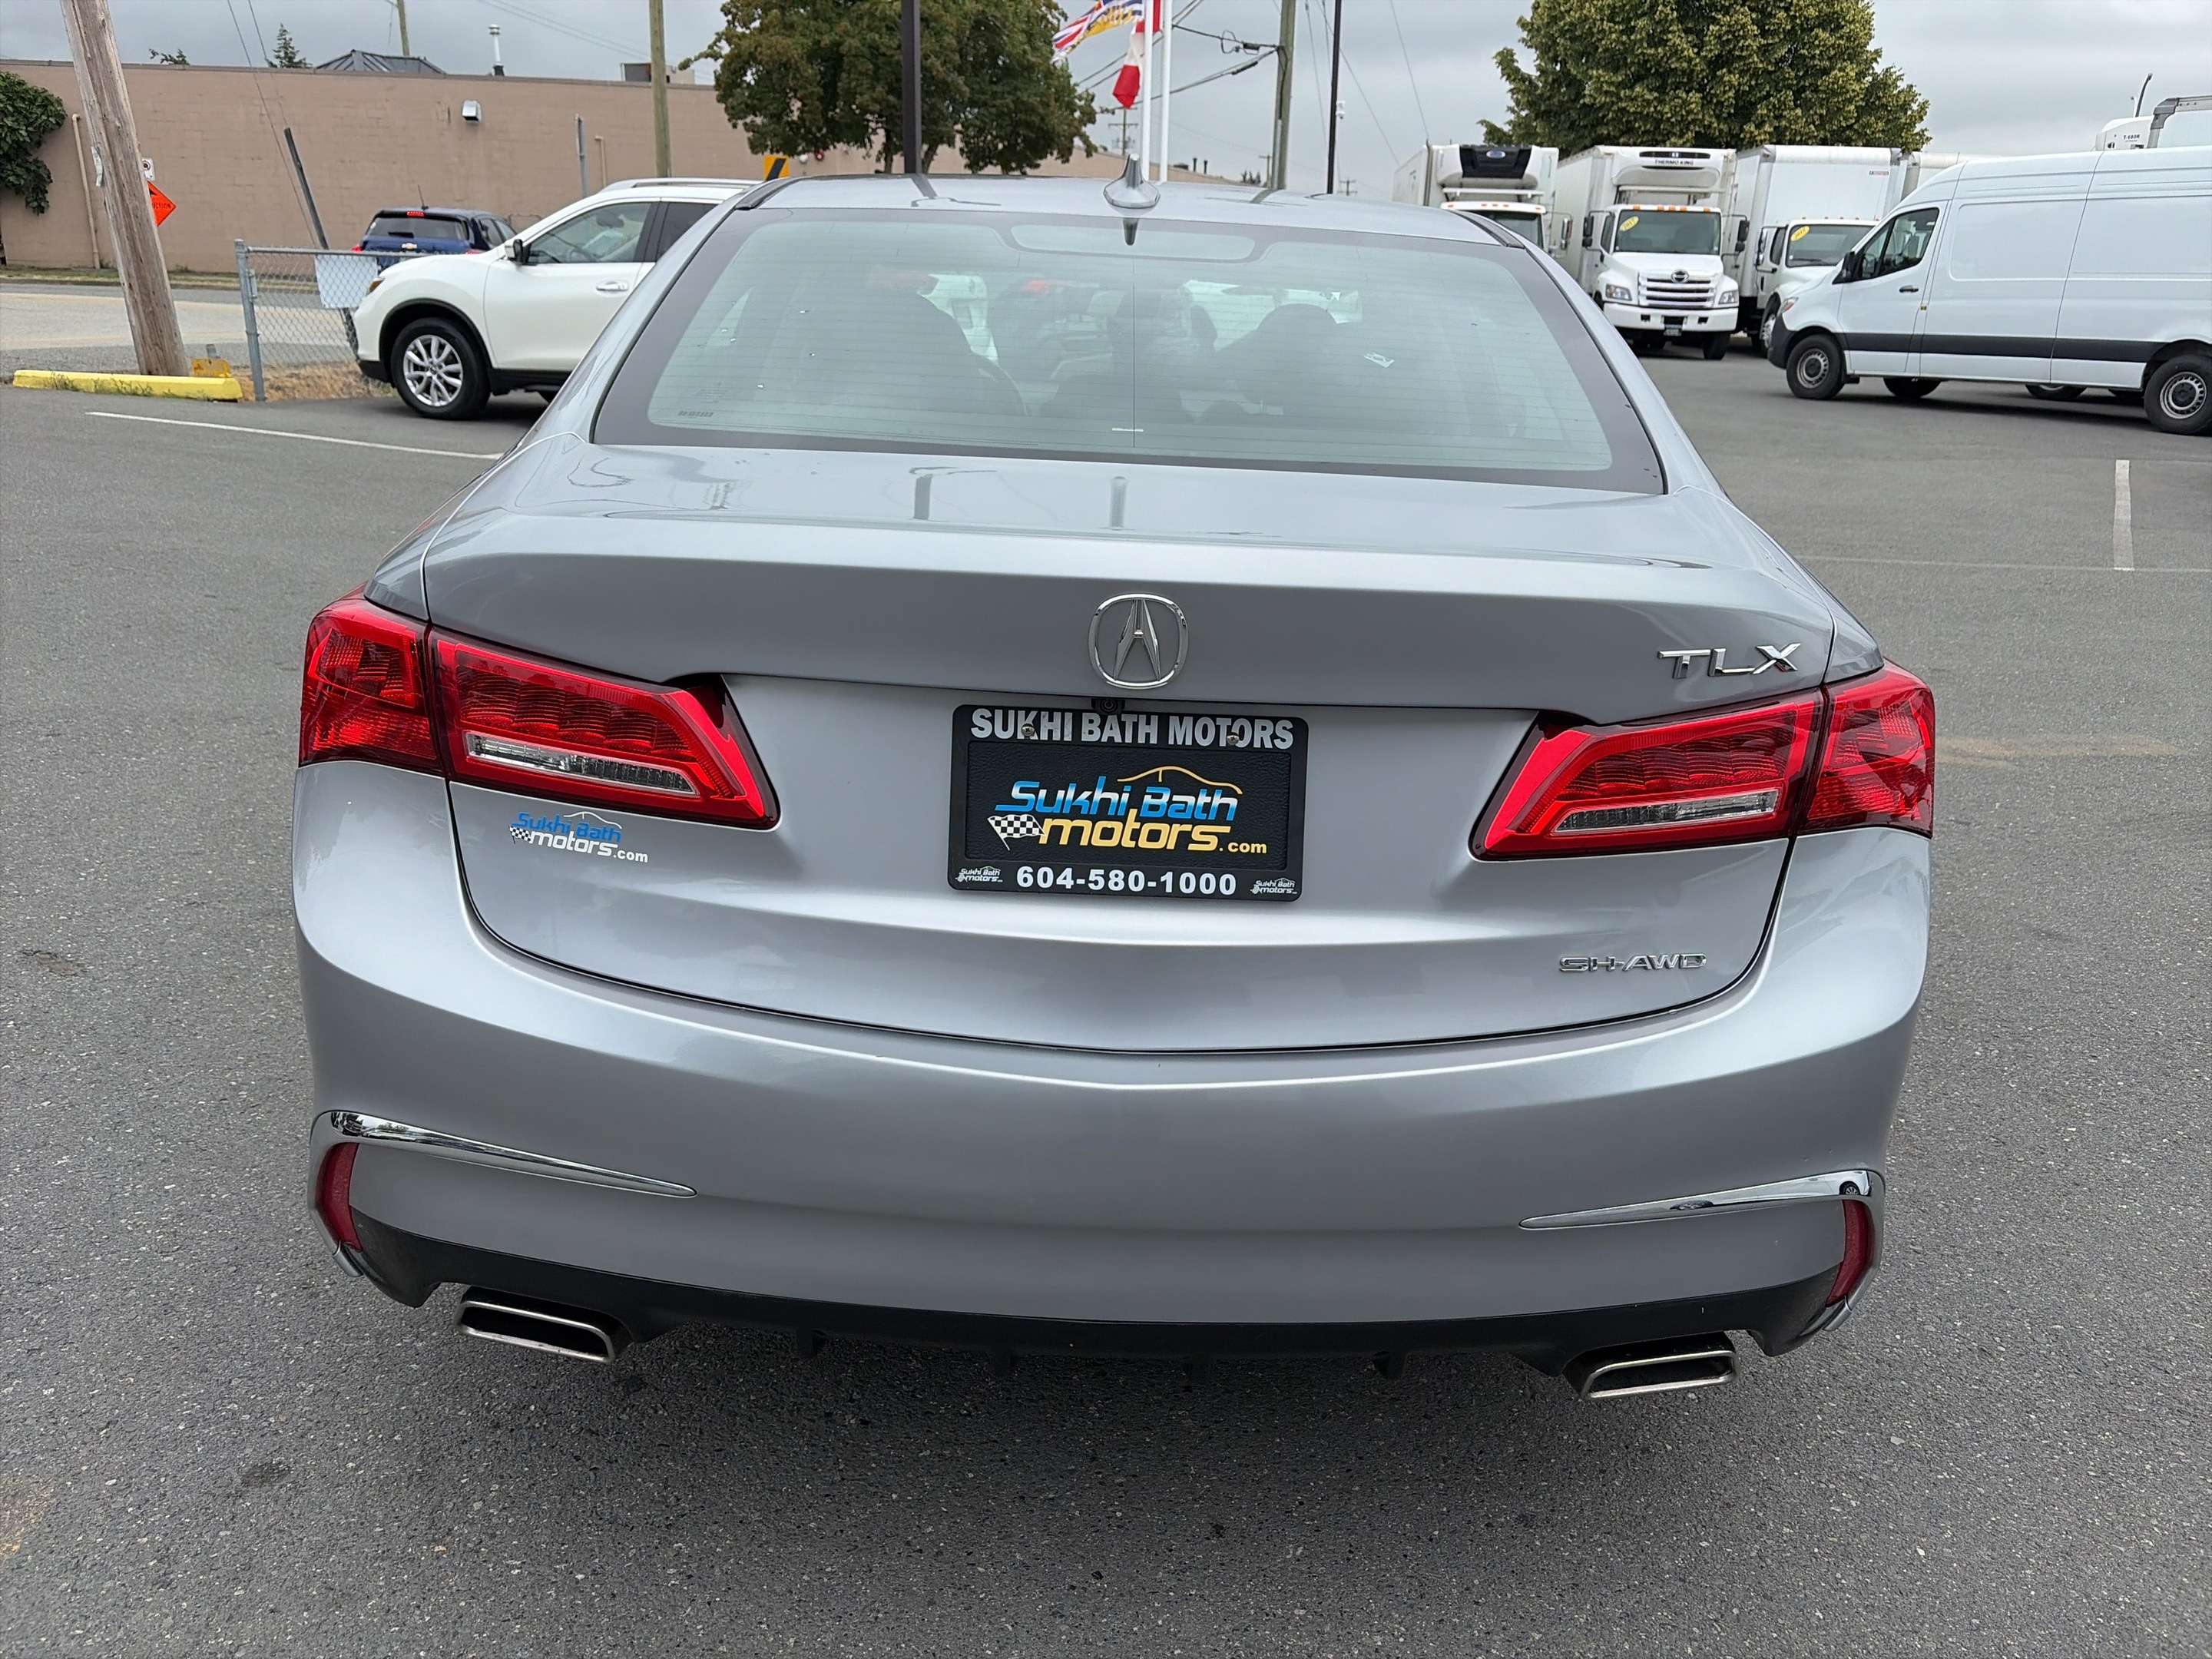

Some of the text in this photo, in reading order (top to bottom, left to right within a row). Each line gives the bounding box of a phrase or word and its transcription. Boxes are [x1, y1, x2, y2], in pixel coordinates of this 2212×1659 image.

[1657, 642, 1801, 679] TLX
[970, 707, 1294, 750] SUKHI BATH MOTORS
[995, 775, 1239, 821] Sukhi Bath
[512, 811, 623, 843] Sukhi Bath
[1016, 866, 1237, 896] 604-580-1000
[1559, 952, 1707, 972] SH-AWD
